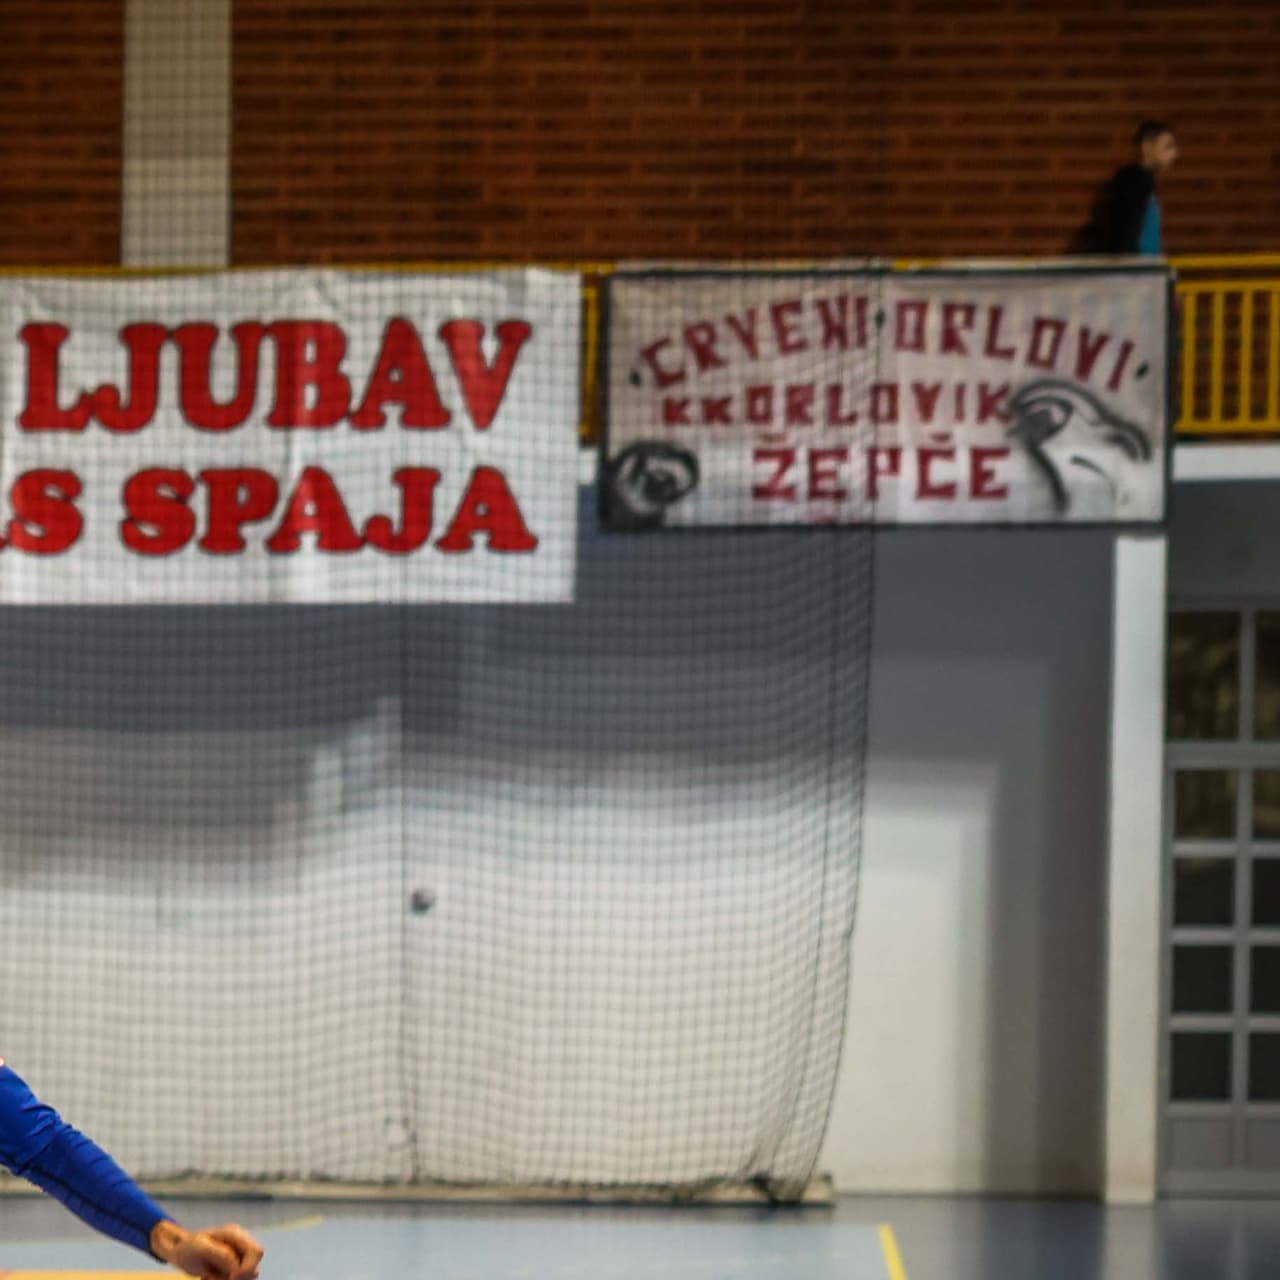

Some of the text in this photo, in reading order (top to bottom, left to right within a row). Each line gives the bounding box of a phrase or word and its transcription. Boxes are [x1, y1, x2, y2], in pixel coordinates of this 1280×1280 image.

[16, 316, 533, 434] LJUBAV
[642, 295, 1135, 392] CRVENI ORLOVI
[118, 465, 540, 556] SPAJA
[752, 432, 1011, 501] ŽEPČE
